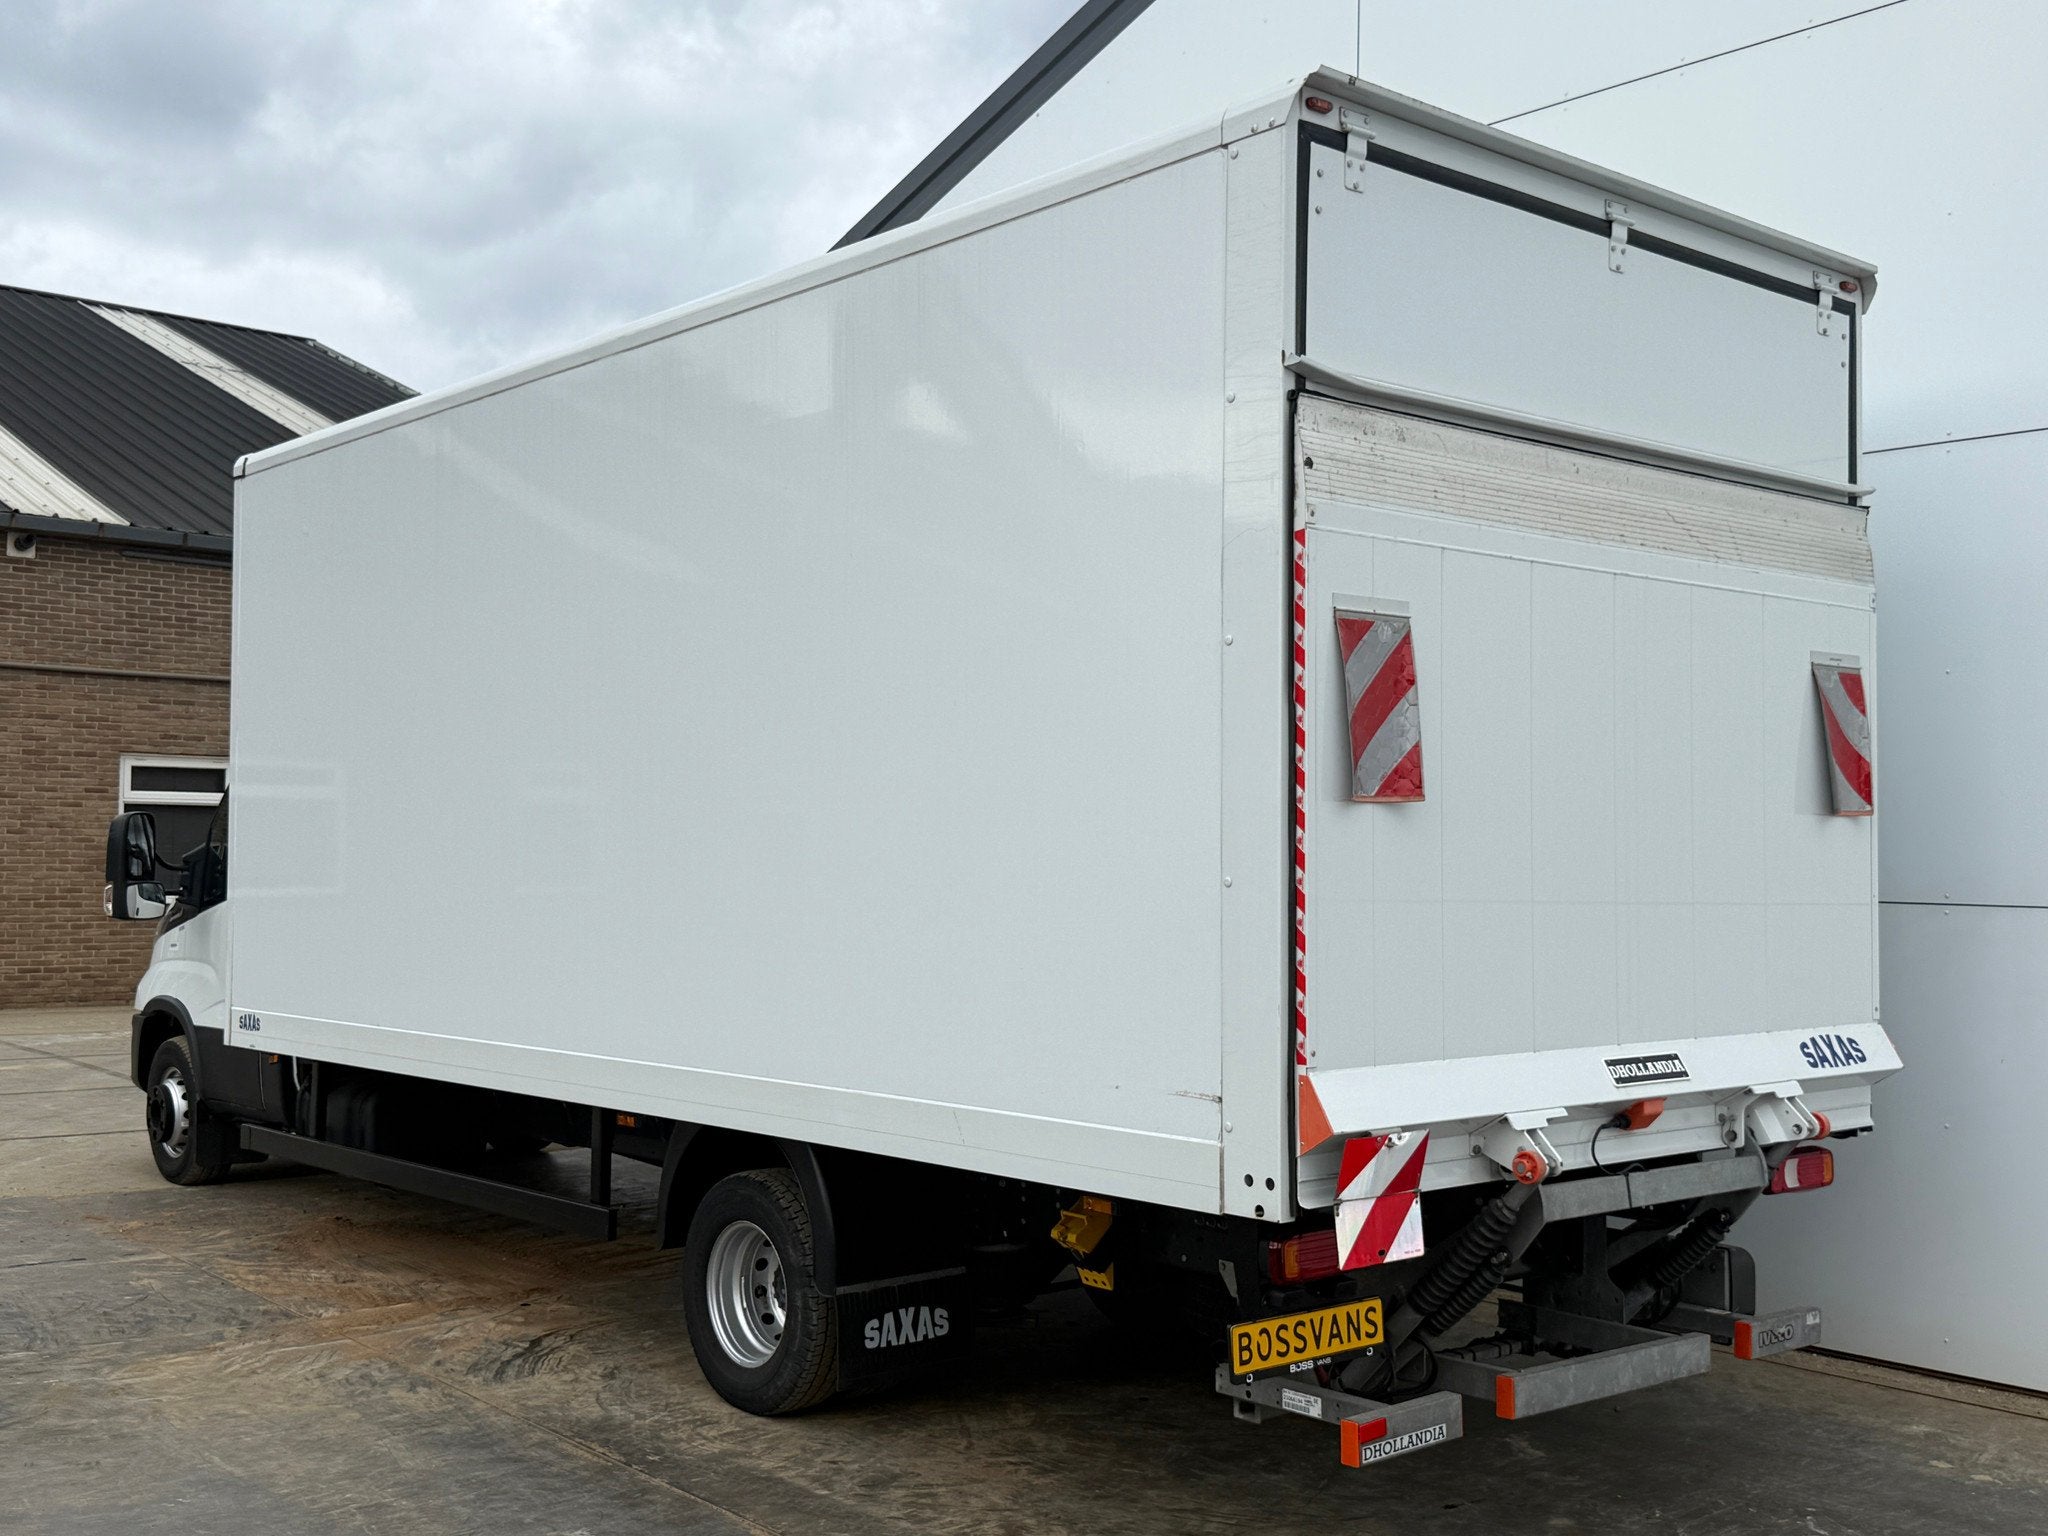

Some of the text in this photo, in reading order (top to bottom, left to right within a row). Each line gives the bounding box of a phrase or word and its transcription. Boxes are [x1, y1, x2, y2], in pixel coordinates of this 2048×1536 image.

[239, 1013, 261, 1031] SAXAS
[1799, 1034, 1867, 1068] SAXAS
[1608, 1058, 1685, 1079] DHOLLANDIA
[864, 1306, 950, 1349] SAXAS
[1238, 1306, 1379, 1367] BOSSVANS
[1289, 1360, 1314, 1373] BOSS
[1363, 1425, 1445, 1461] DHOLLANDIA
